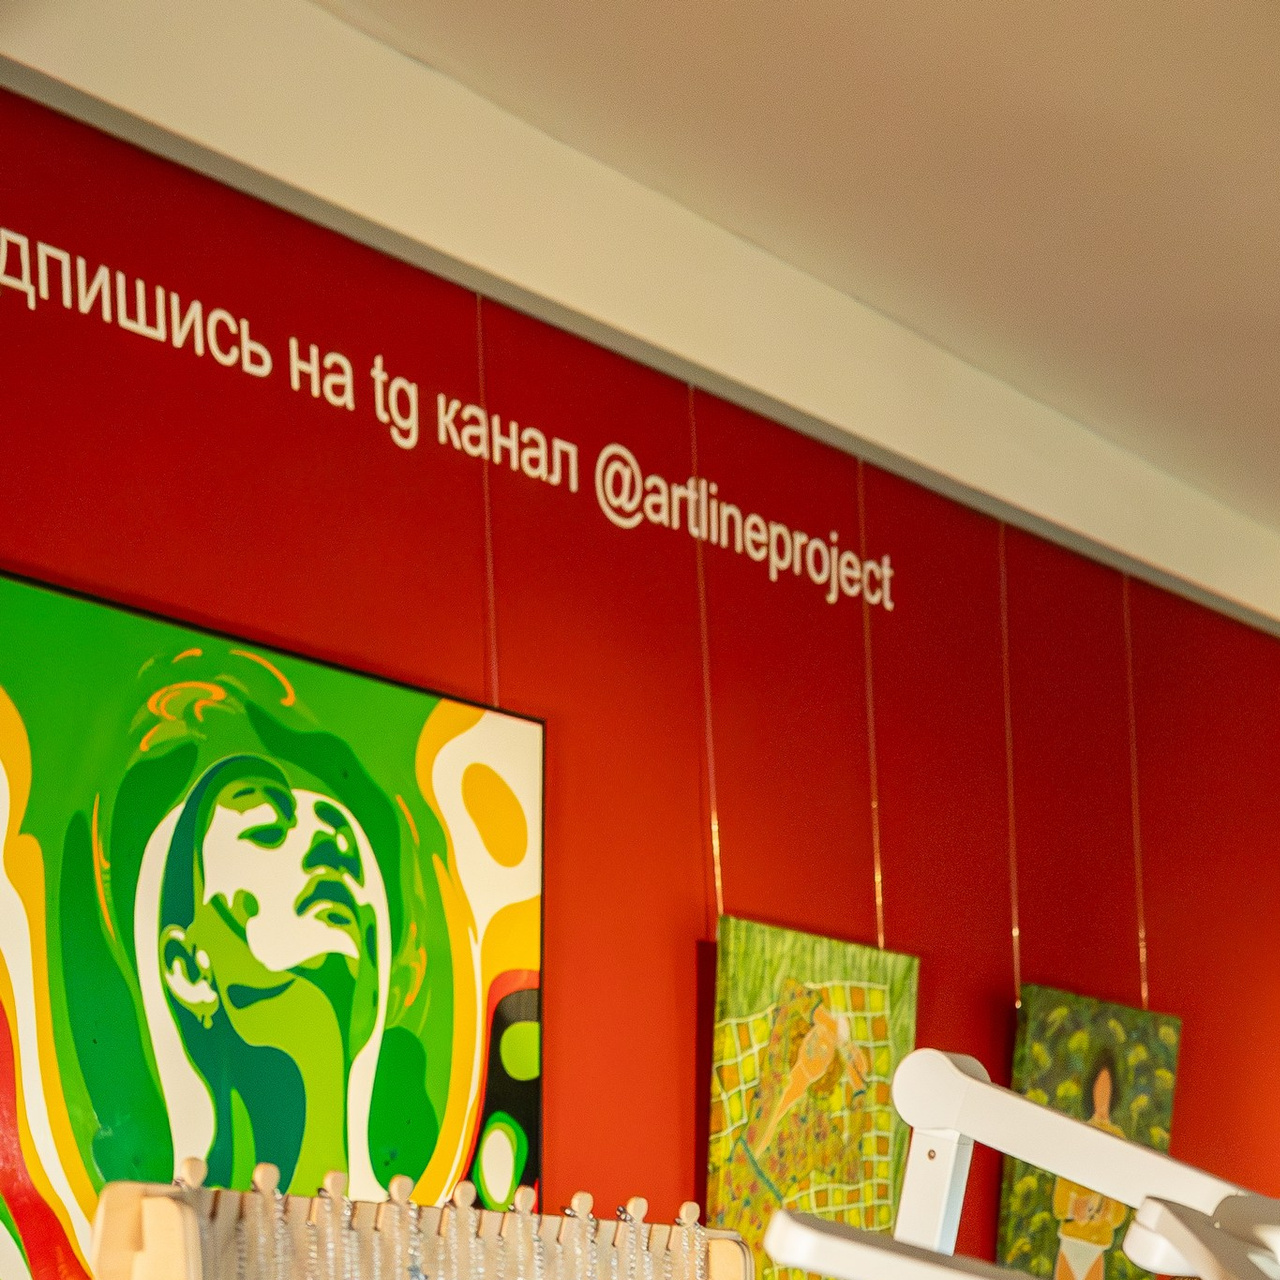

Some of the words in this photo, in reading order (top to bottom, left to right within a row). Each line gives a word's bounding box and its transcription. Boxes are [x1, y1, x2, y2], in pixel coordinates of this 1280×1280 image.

[288, 336, 356, 411] на
[370, 354, 420, 450] tg
[436, 392, 580, 494] канал
[594, 442, 896, 611] @artlineproject
